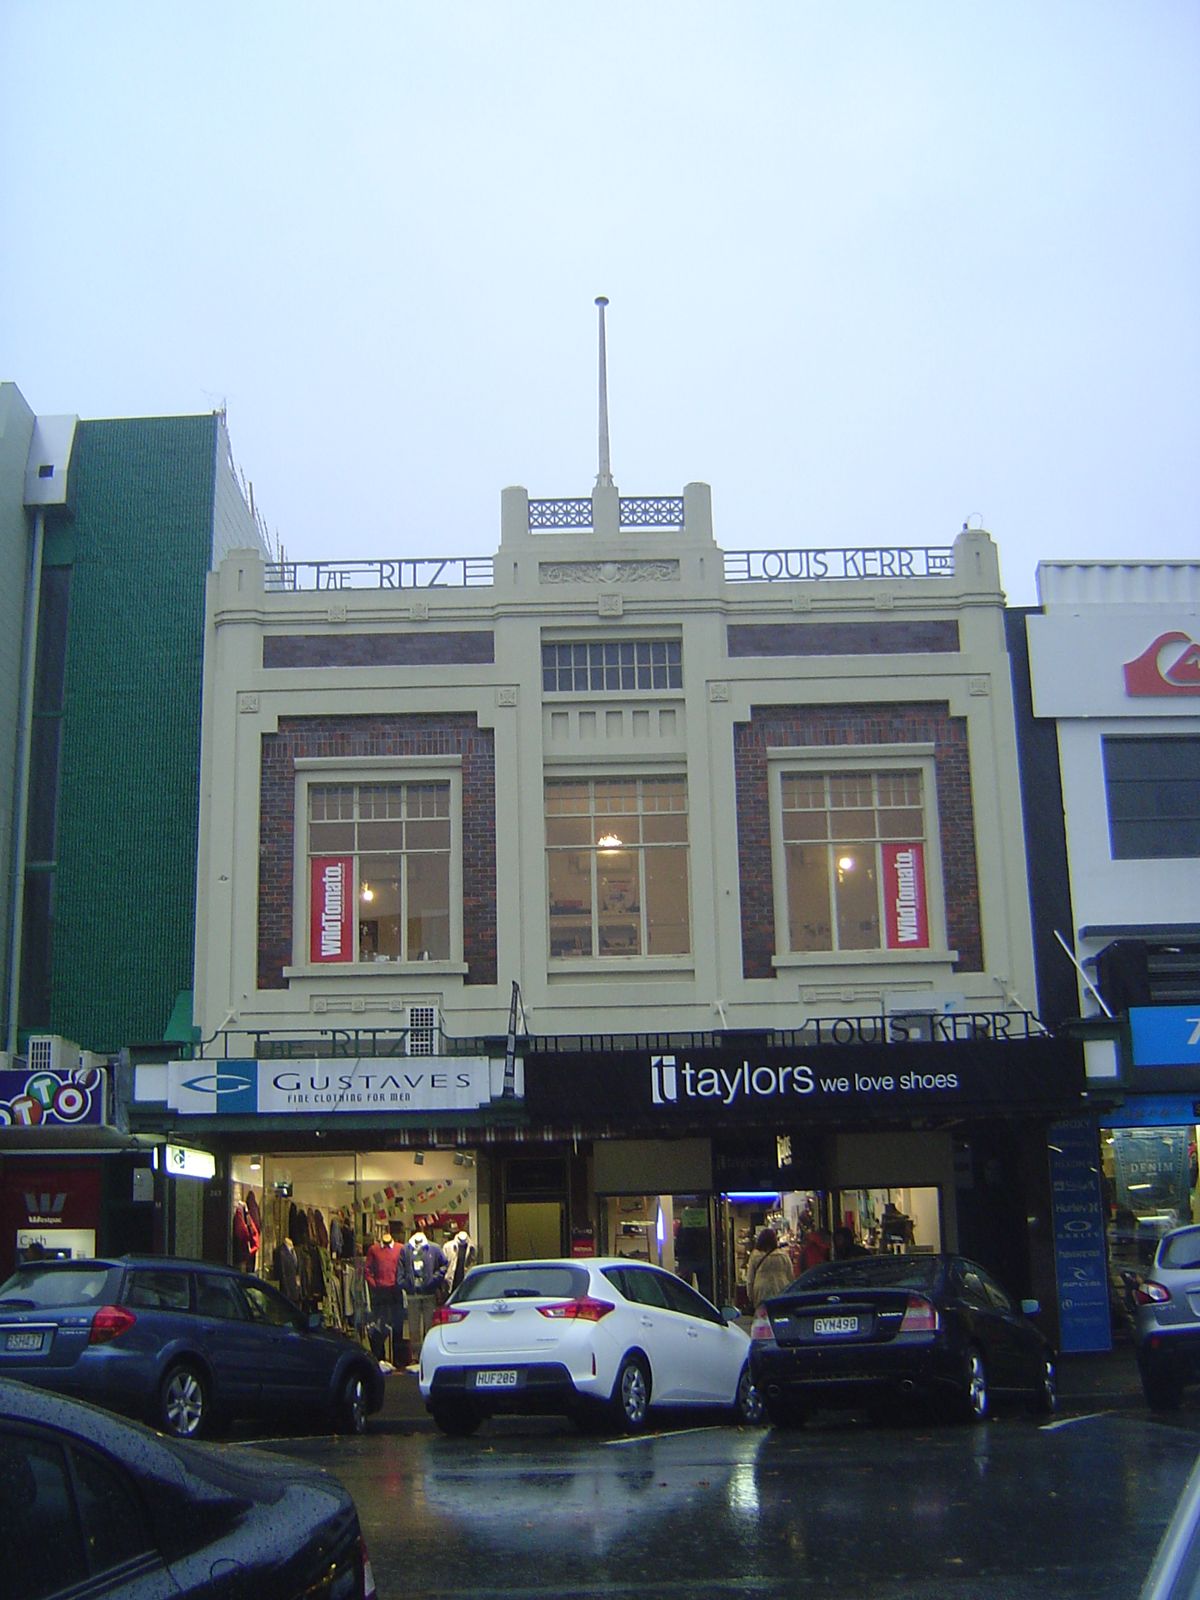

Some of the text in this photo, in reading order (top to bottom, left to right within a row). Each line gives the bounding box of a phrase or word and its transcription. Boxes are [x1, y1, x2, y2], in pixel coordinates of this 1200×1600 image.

[746, 551, 828, 579] LOUIS
[842, 550, 914, 577] KERR
[272, 1072, 471, 1091] GUSTAVES
[681, 1061, 815, 1105] taylors
[819, 1077, 849, 1093] we
[854, 1072, 895, 1092] love
[899, 1070, 959, 1090] shoes
[287, 1091, 411, 1104] FINE CLOTHING FOR MEN
[1130, 1162, 1173, 1173] DENIM
